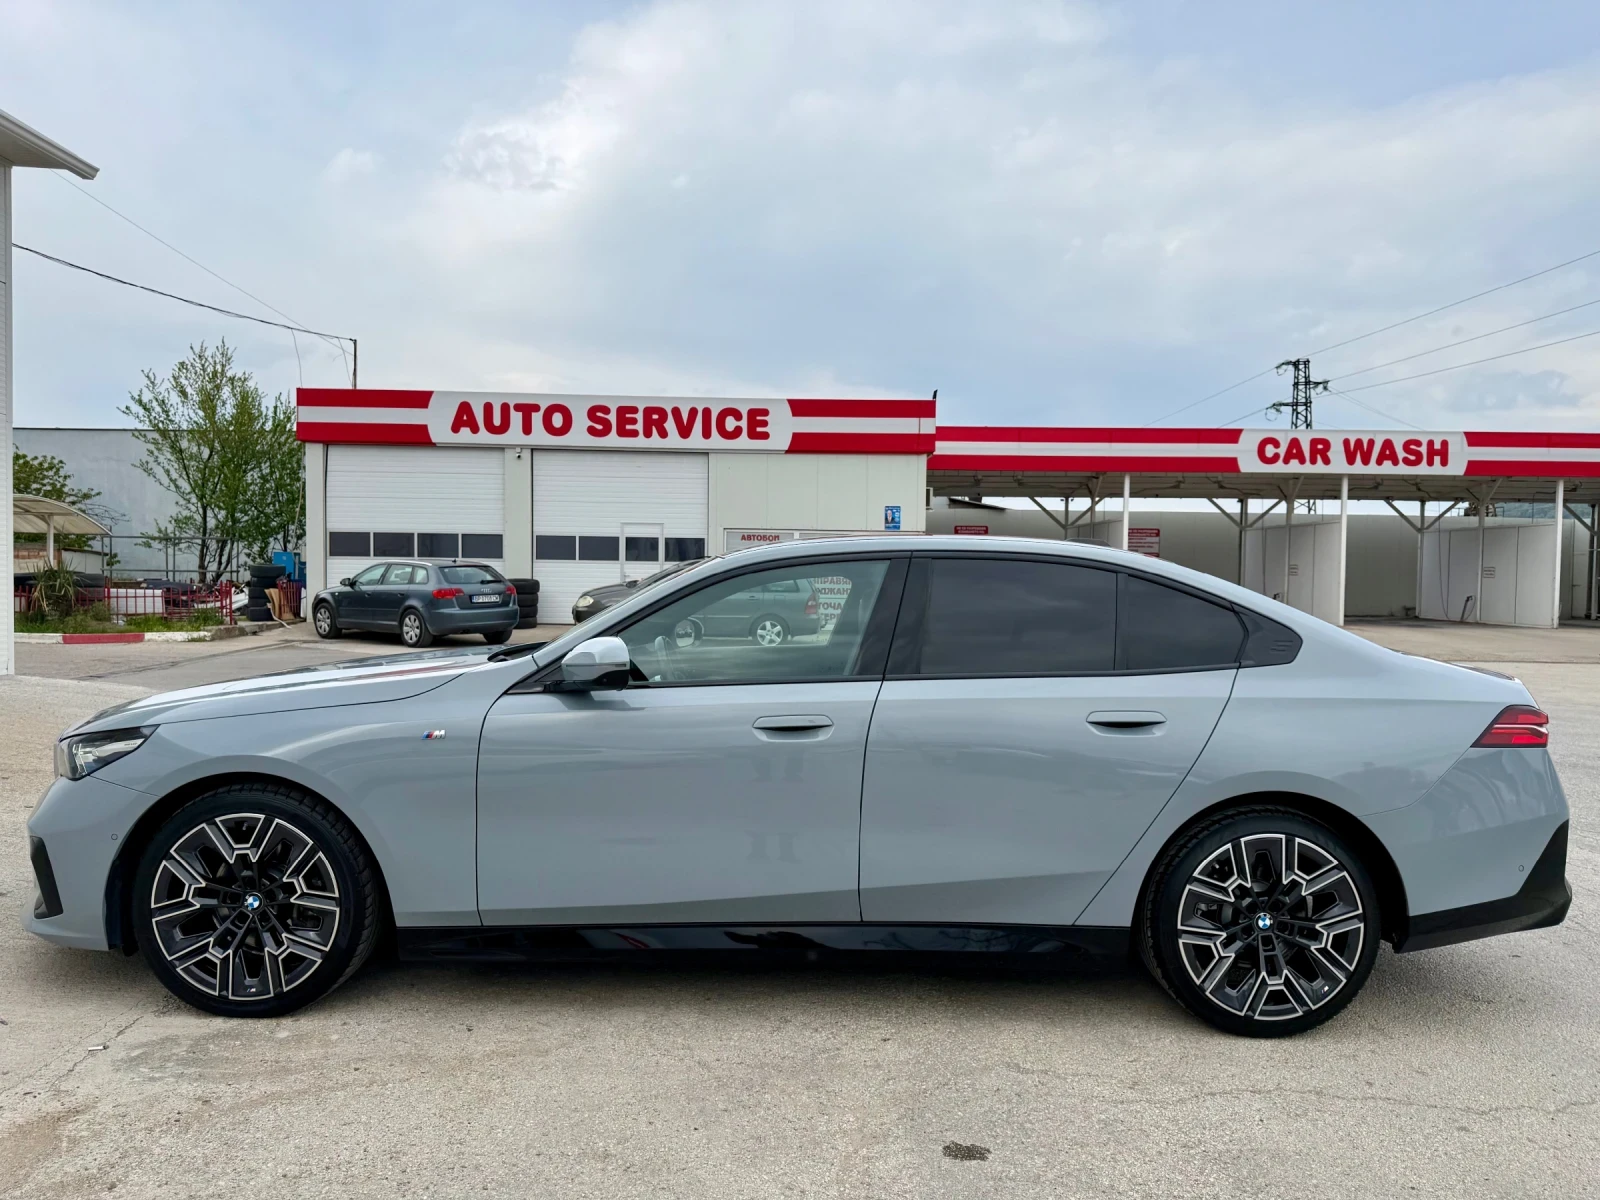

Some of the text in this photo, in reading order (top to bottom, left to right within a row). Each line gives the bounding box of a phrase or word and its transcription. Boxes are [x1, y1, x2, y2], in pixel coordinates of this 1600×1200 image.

[450, 401, 771, 441] AUTO SERVICE
[1257, 437, 1449, 467] CAR WASH
